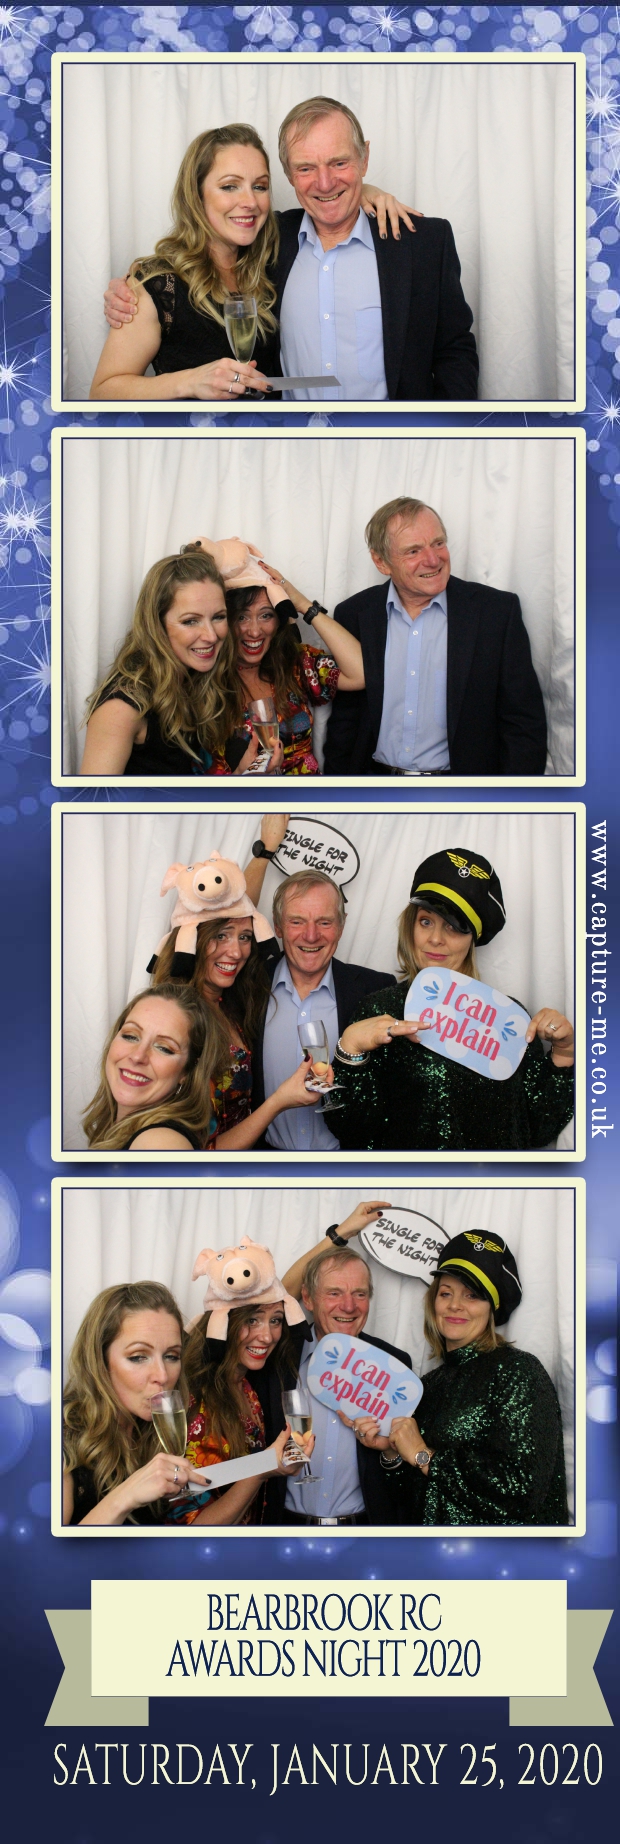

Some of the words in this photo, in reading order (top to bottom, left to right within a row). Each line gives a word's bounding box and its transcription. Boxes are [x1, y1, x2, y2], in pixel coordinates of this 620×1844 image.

[276, 843, 301, 860] THE
[301, 854, 345, 876] NIGHT
[283, 829, 325, 853] SINGLE
[325, 847, 349, 863] FOR
[442, 981, 457, 1006] I
[454, 993, 498, 1028] can
[418, 1007, 501, 1062] explain
[371, 1231, 397, 1249] THE
[397, 1243, 440, 1267] NIGHT
[375, 1218, 421, 1243] SINGLE
[421, 1237, 445, 1255] FOR
[340, 1347, 356, 1370] I
[351, 1358, 392, 1392] can
[319, 1370, 391, 1421] explain
